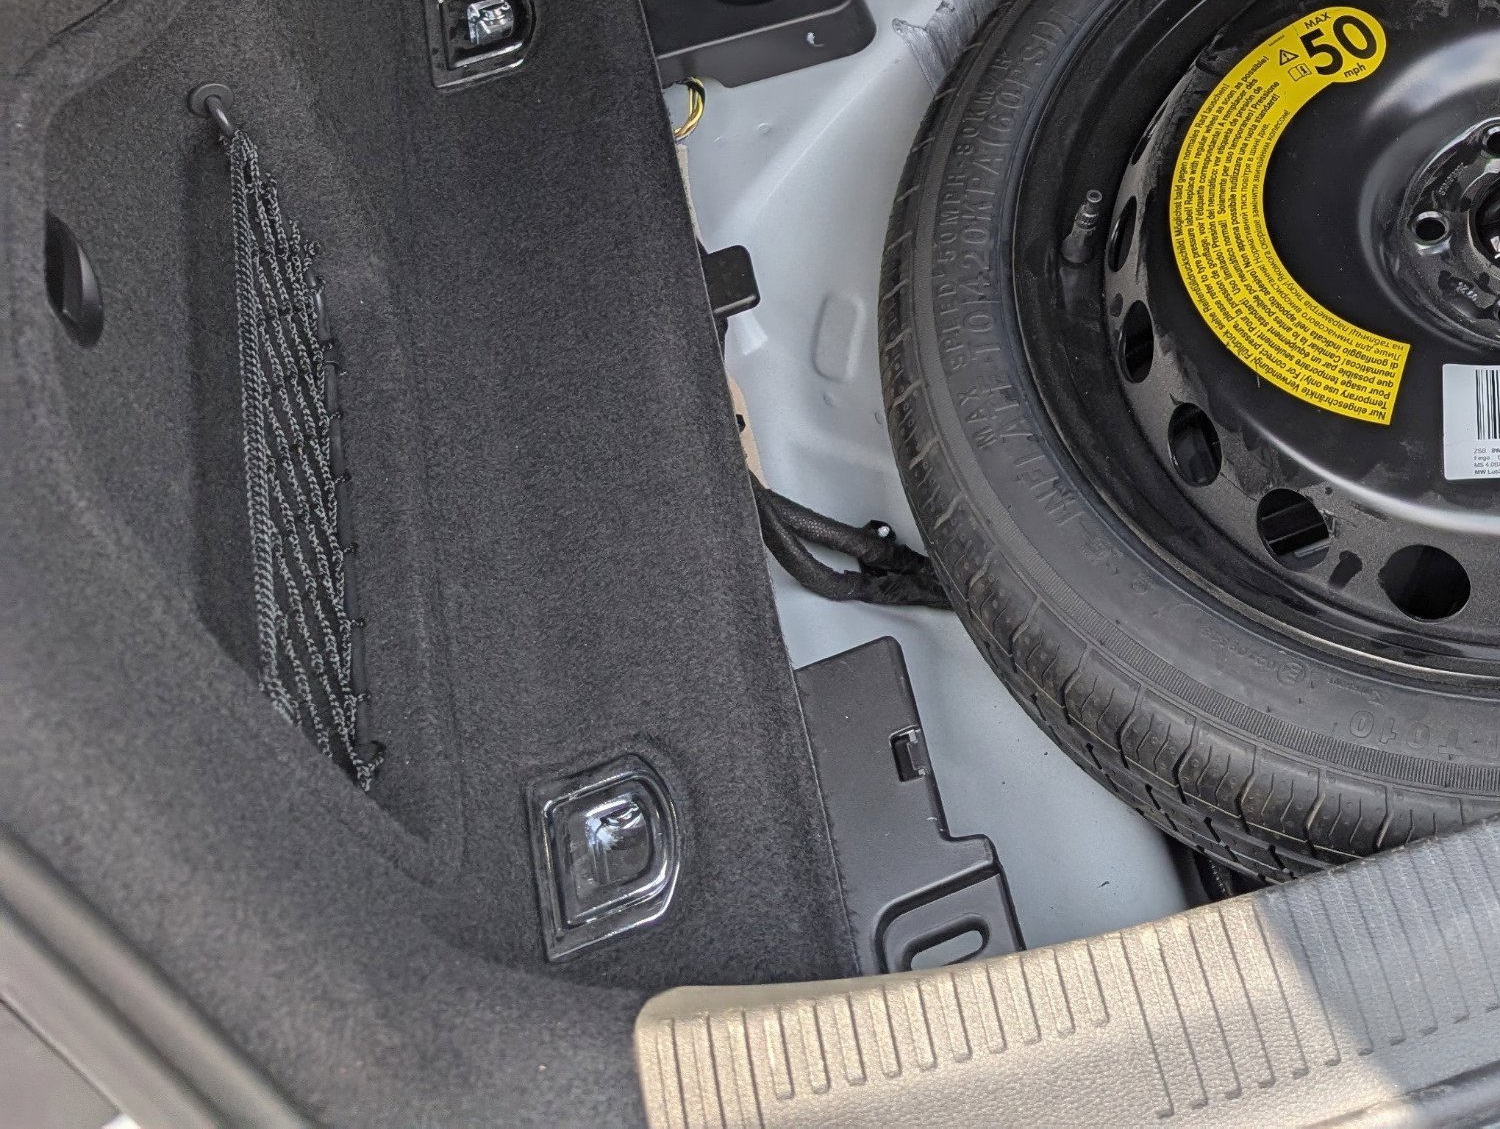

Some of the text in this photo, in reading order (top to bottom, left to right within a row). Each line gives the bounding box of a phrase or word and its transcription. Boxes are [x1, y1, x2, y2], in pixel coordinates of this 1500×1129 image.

[1303, 12, 1332, 30] MAX
[1300, 15, 1378, 76] 50
[1343, 62, 1367, 79] mph
